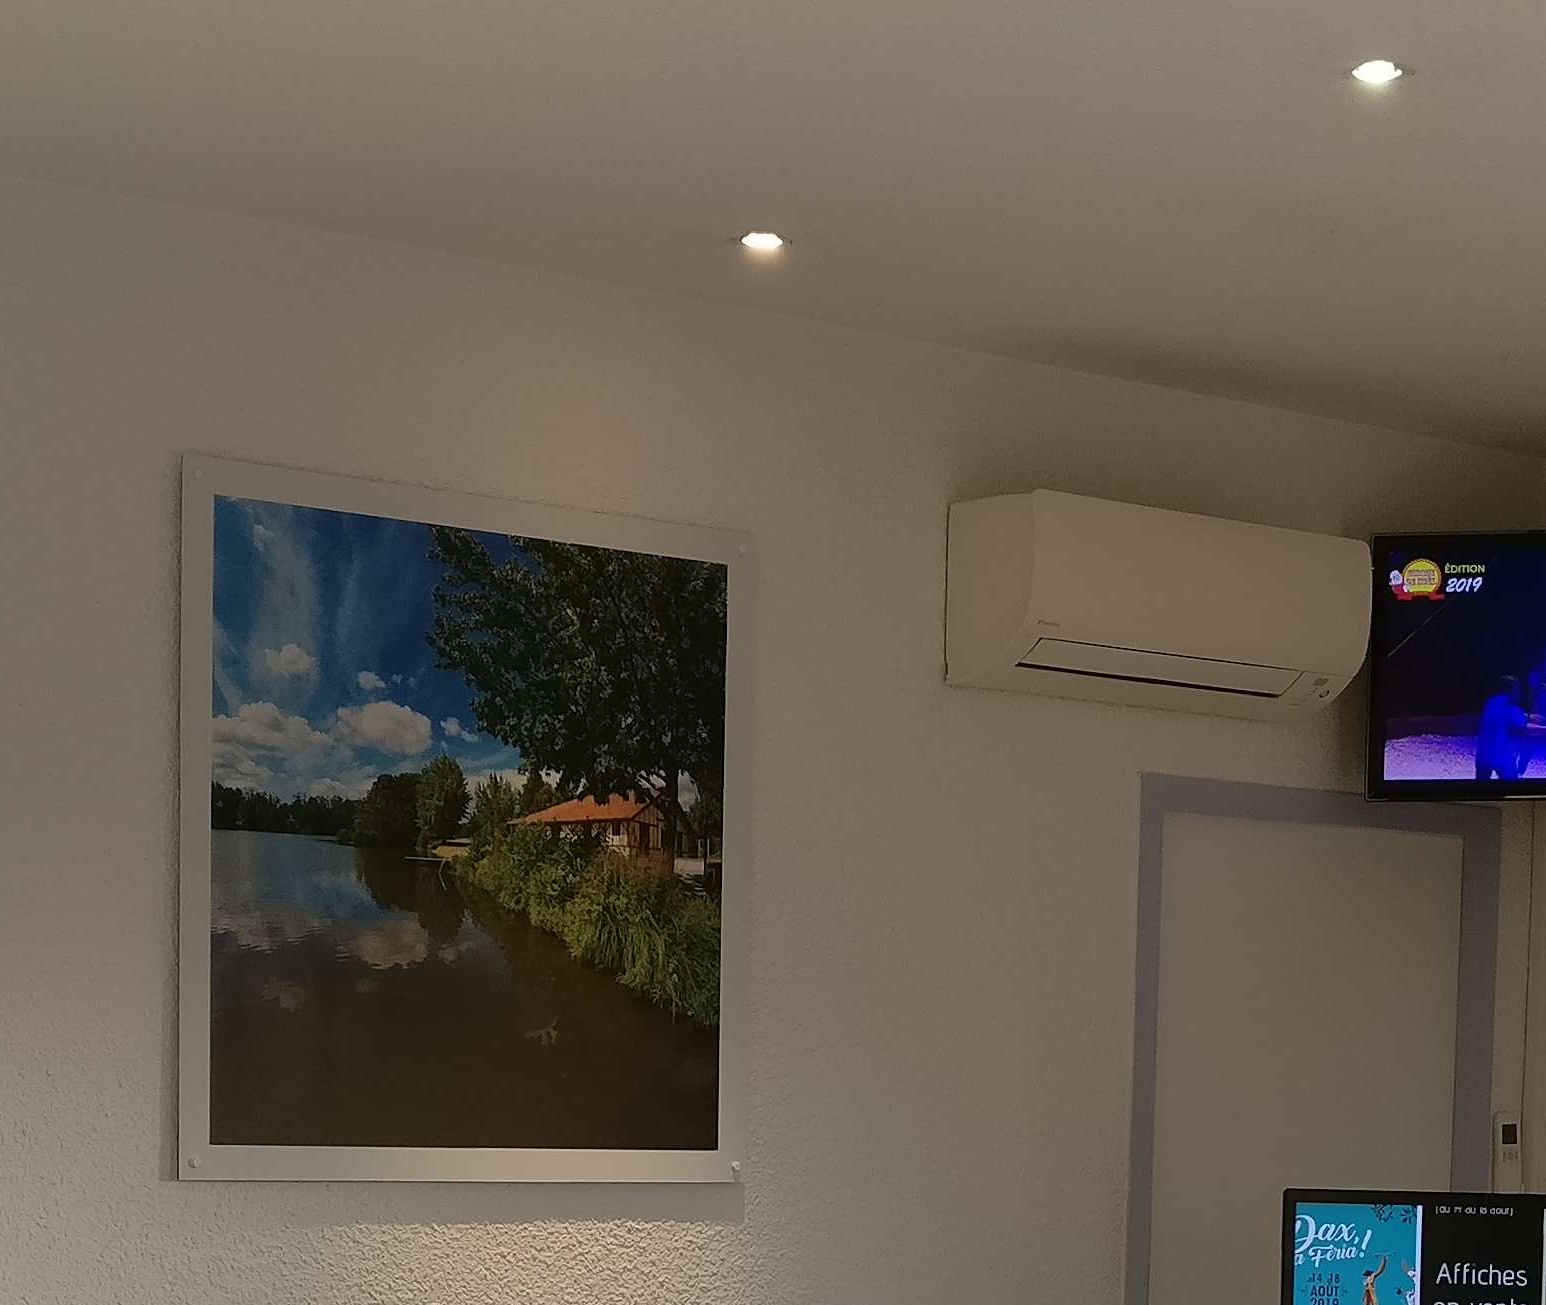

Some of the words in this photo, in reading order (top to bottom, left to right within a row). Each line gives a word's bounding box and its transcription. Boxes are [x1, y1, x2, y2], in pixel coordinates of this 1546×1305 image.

[1444, 563, 1486, 573] ÉDITION
[1446, 577, 1483, 592] 2019
[1435, 1262, 1528, 1288] Affiches
